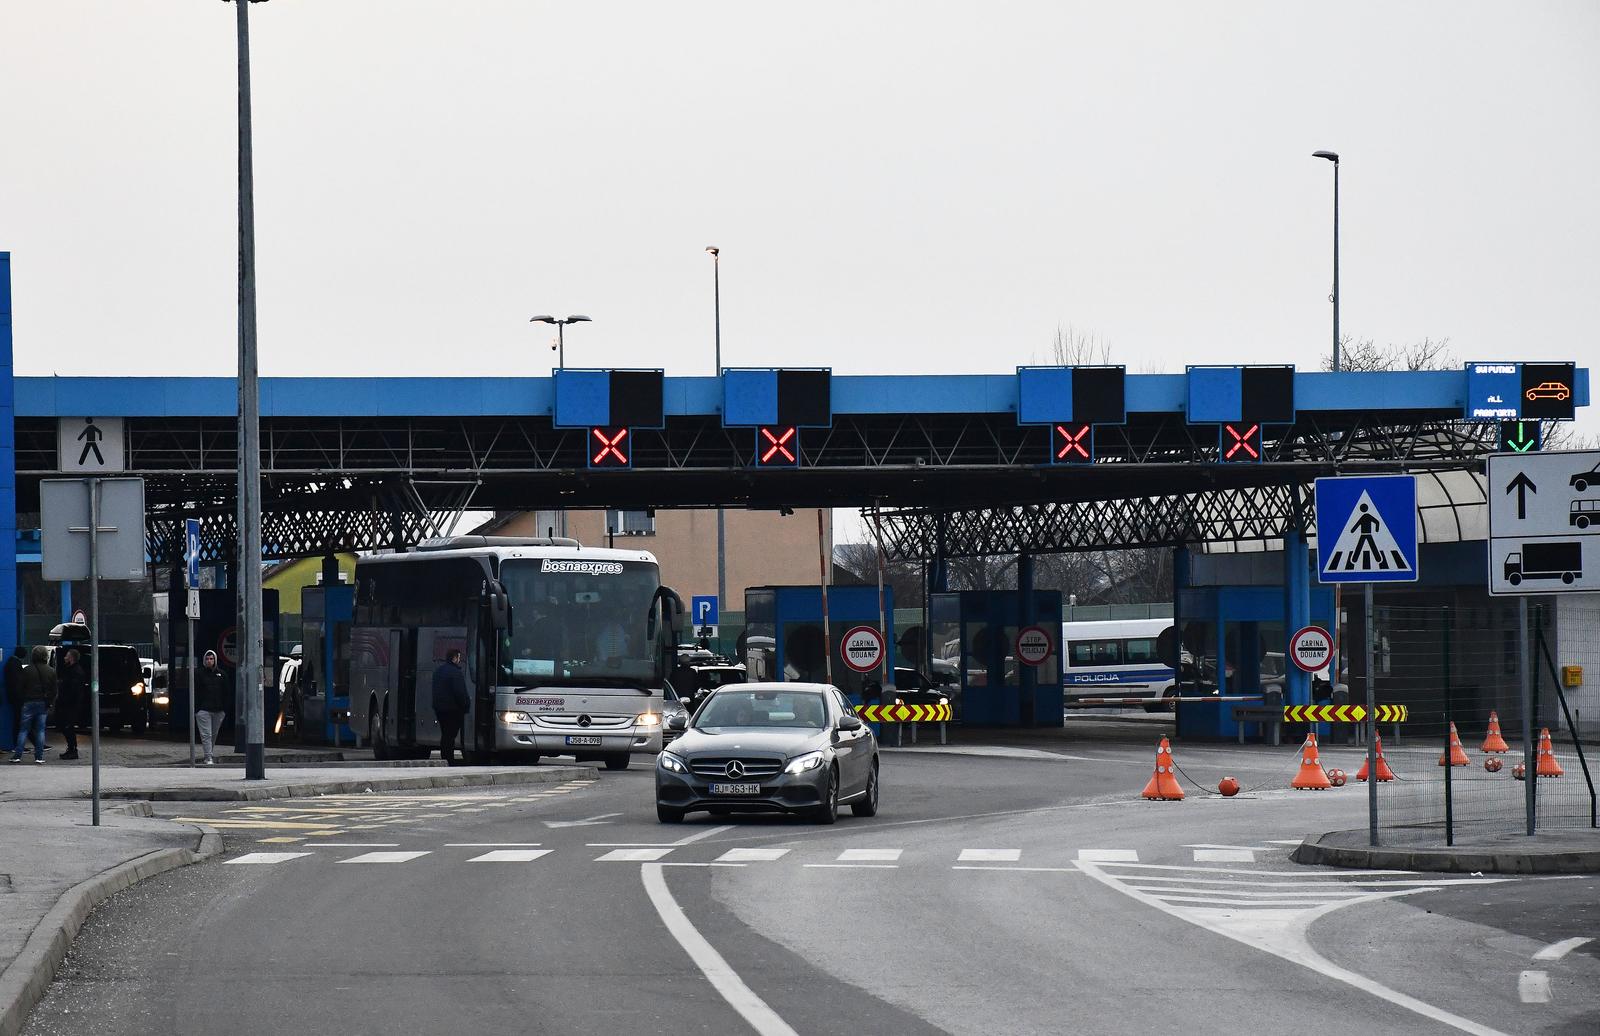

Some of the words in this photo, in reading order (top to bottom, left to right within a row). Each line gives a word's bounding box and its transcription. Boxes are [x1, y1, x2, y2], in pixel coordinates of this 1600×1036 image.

[1473, 409, 1516, 417] PASSPORTS
[190, 533, 197, 574] P
[541, 559, 623, 575] bosnaexpres
[699, 601, 711, 620] P
[851, 640, 875, 648] CARINA
[1074, 674, 1119, 682] POLICIJA
[515, 697, 565, 706] bosnaexpres
[714, 784, 724, 794] BJ
[730, 784, 759, 794] 363-HK
